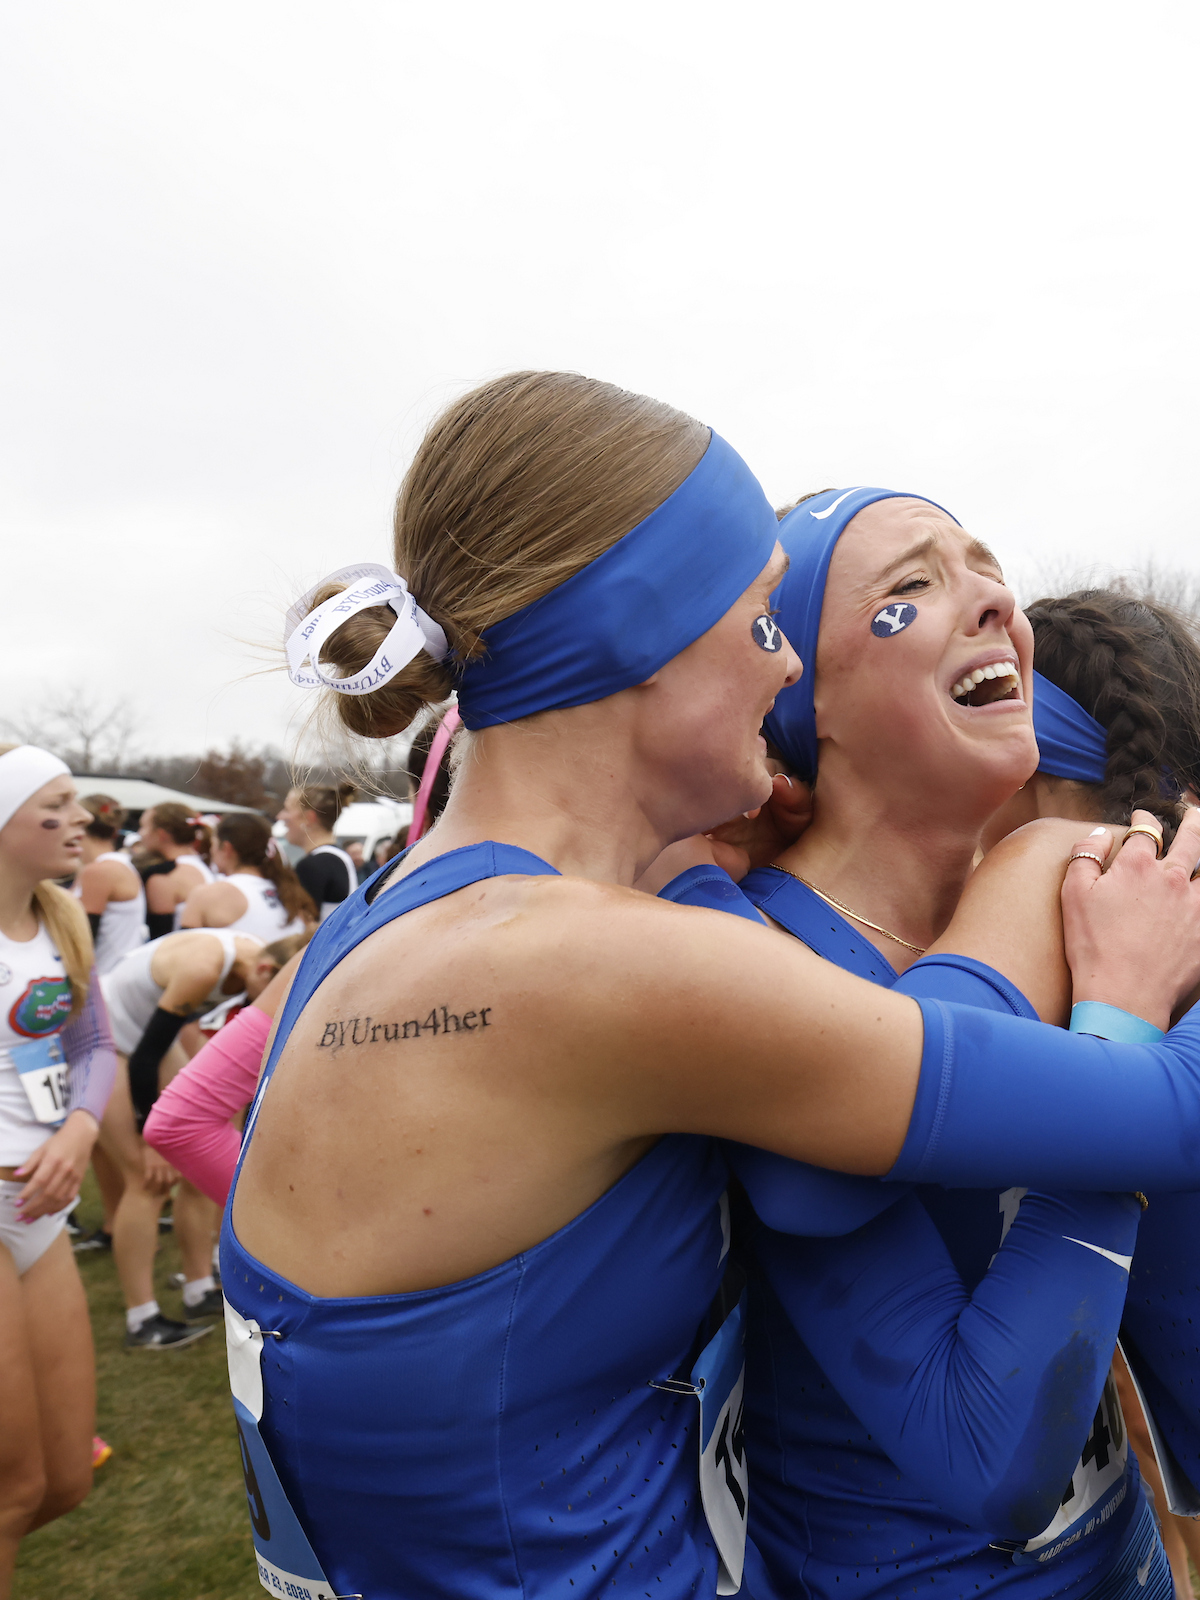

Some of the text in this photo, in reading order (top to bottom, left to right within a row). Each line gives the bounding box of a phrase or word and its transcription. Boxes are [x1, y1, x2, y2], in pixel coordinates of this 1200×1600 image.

[757, 617, 777, 650] Y
[874, 604, 908, 633] Y
[317, 1004, 492, 1048] BYUrun4her
